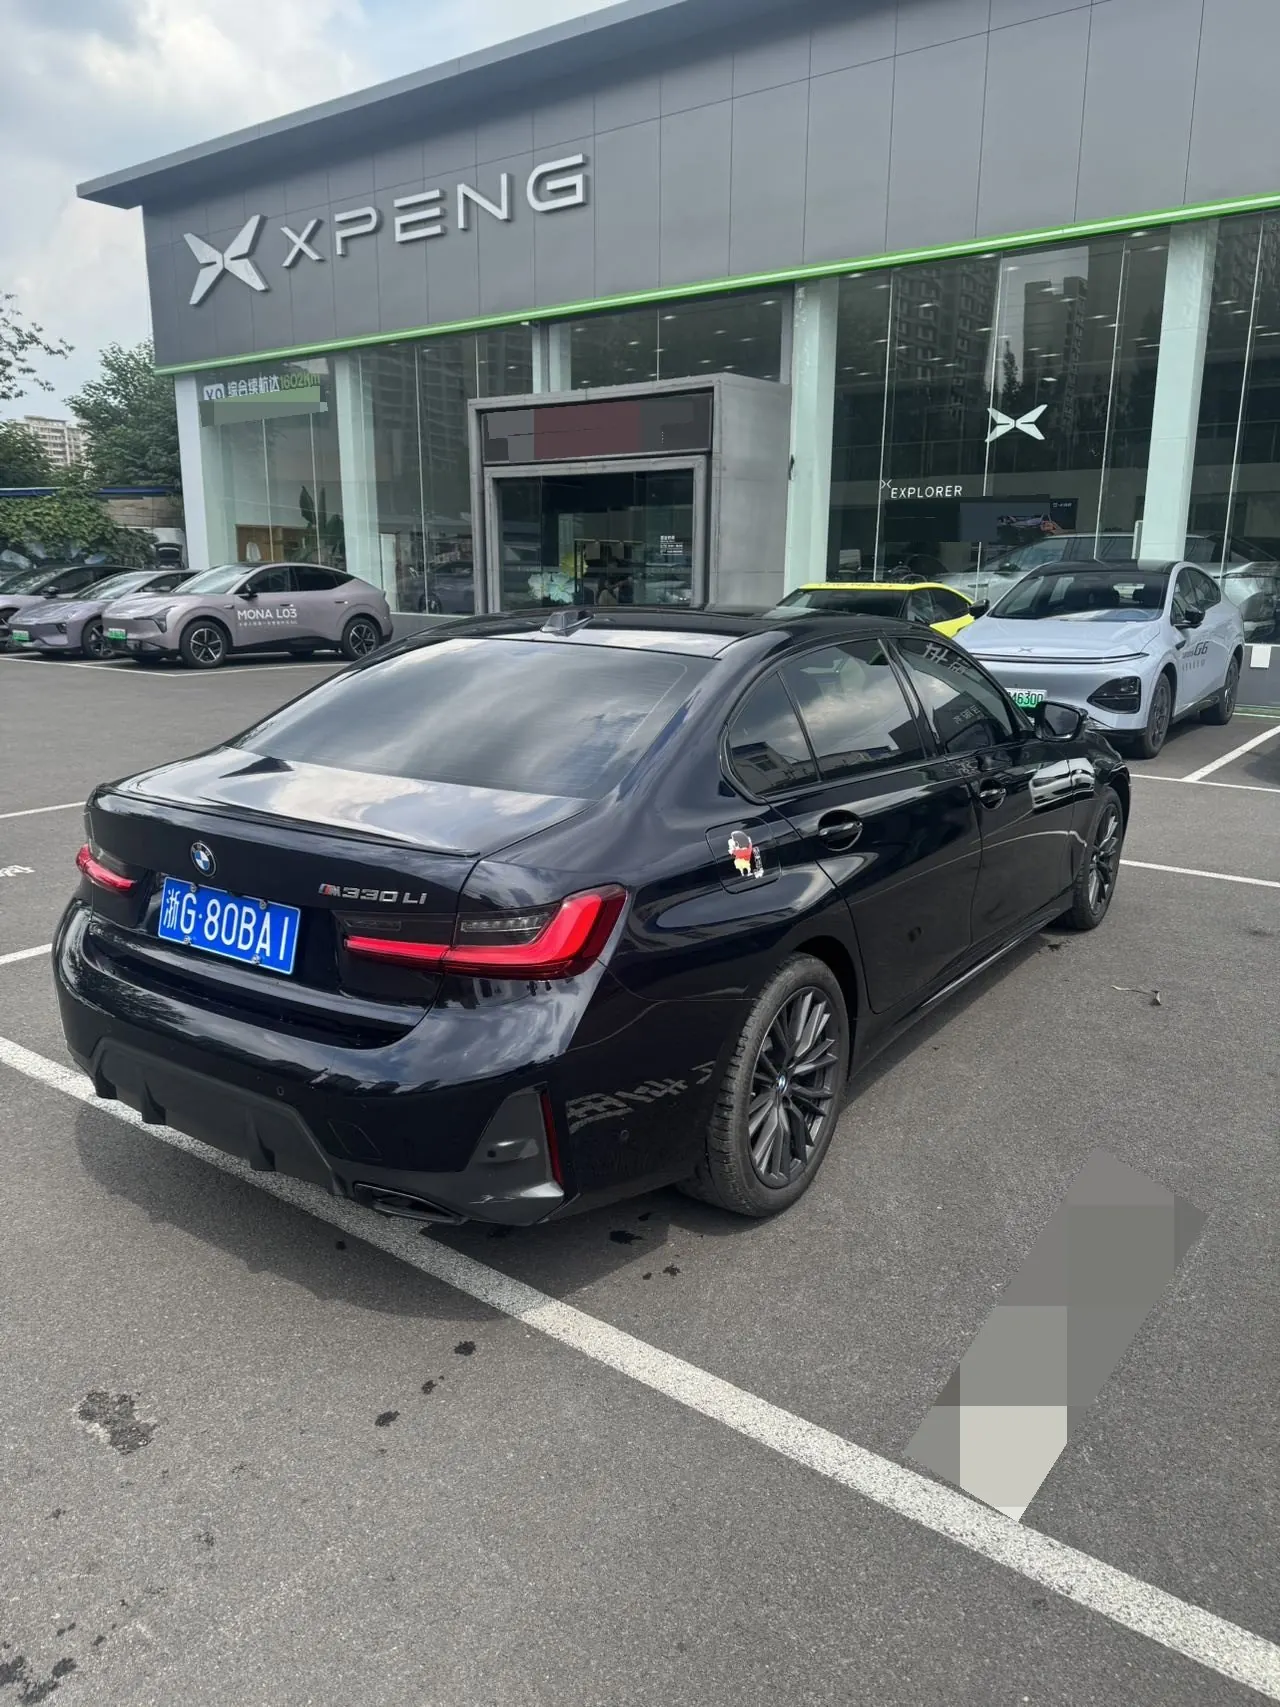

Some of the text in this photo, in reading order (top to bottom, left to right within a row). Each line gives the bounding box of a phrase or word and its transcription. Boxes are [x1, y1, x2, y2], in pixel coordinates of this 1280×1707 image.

[280, 153, 588, 268] XPENG
[890, 485, 963, 499] EXPLORER
[237, 608, 297, 621] MONA L03
[1194, 641, 1209, 656] G6
